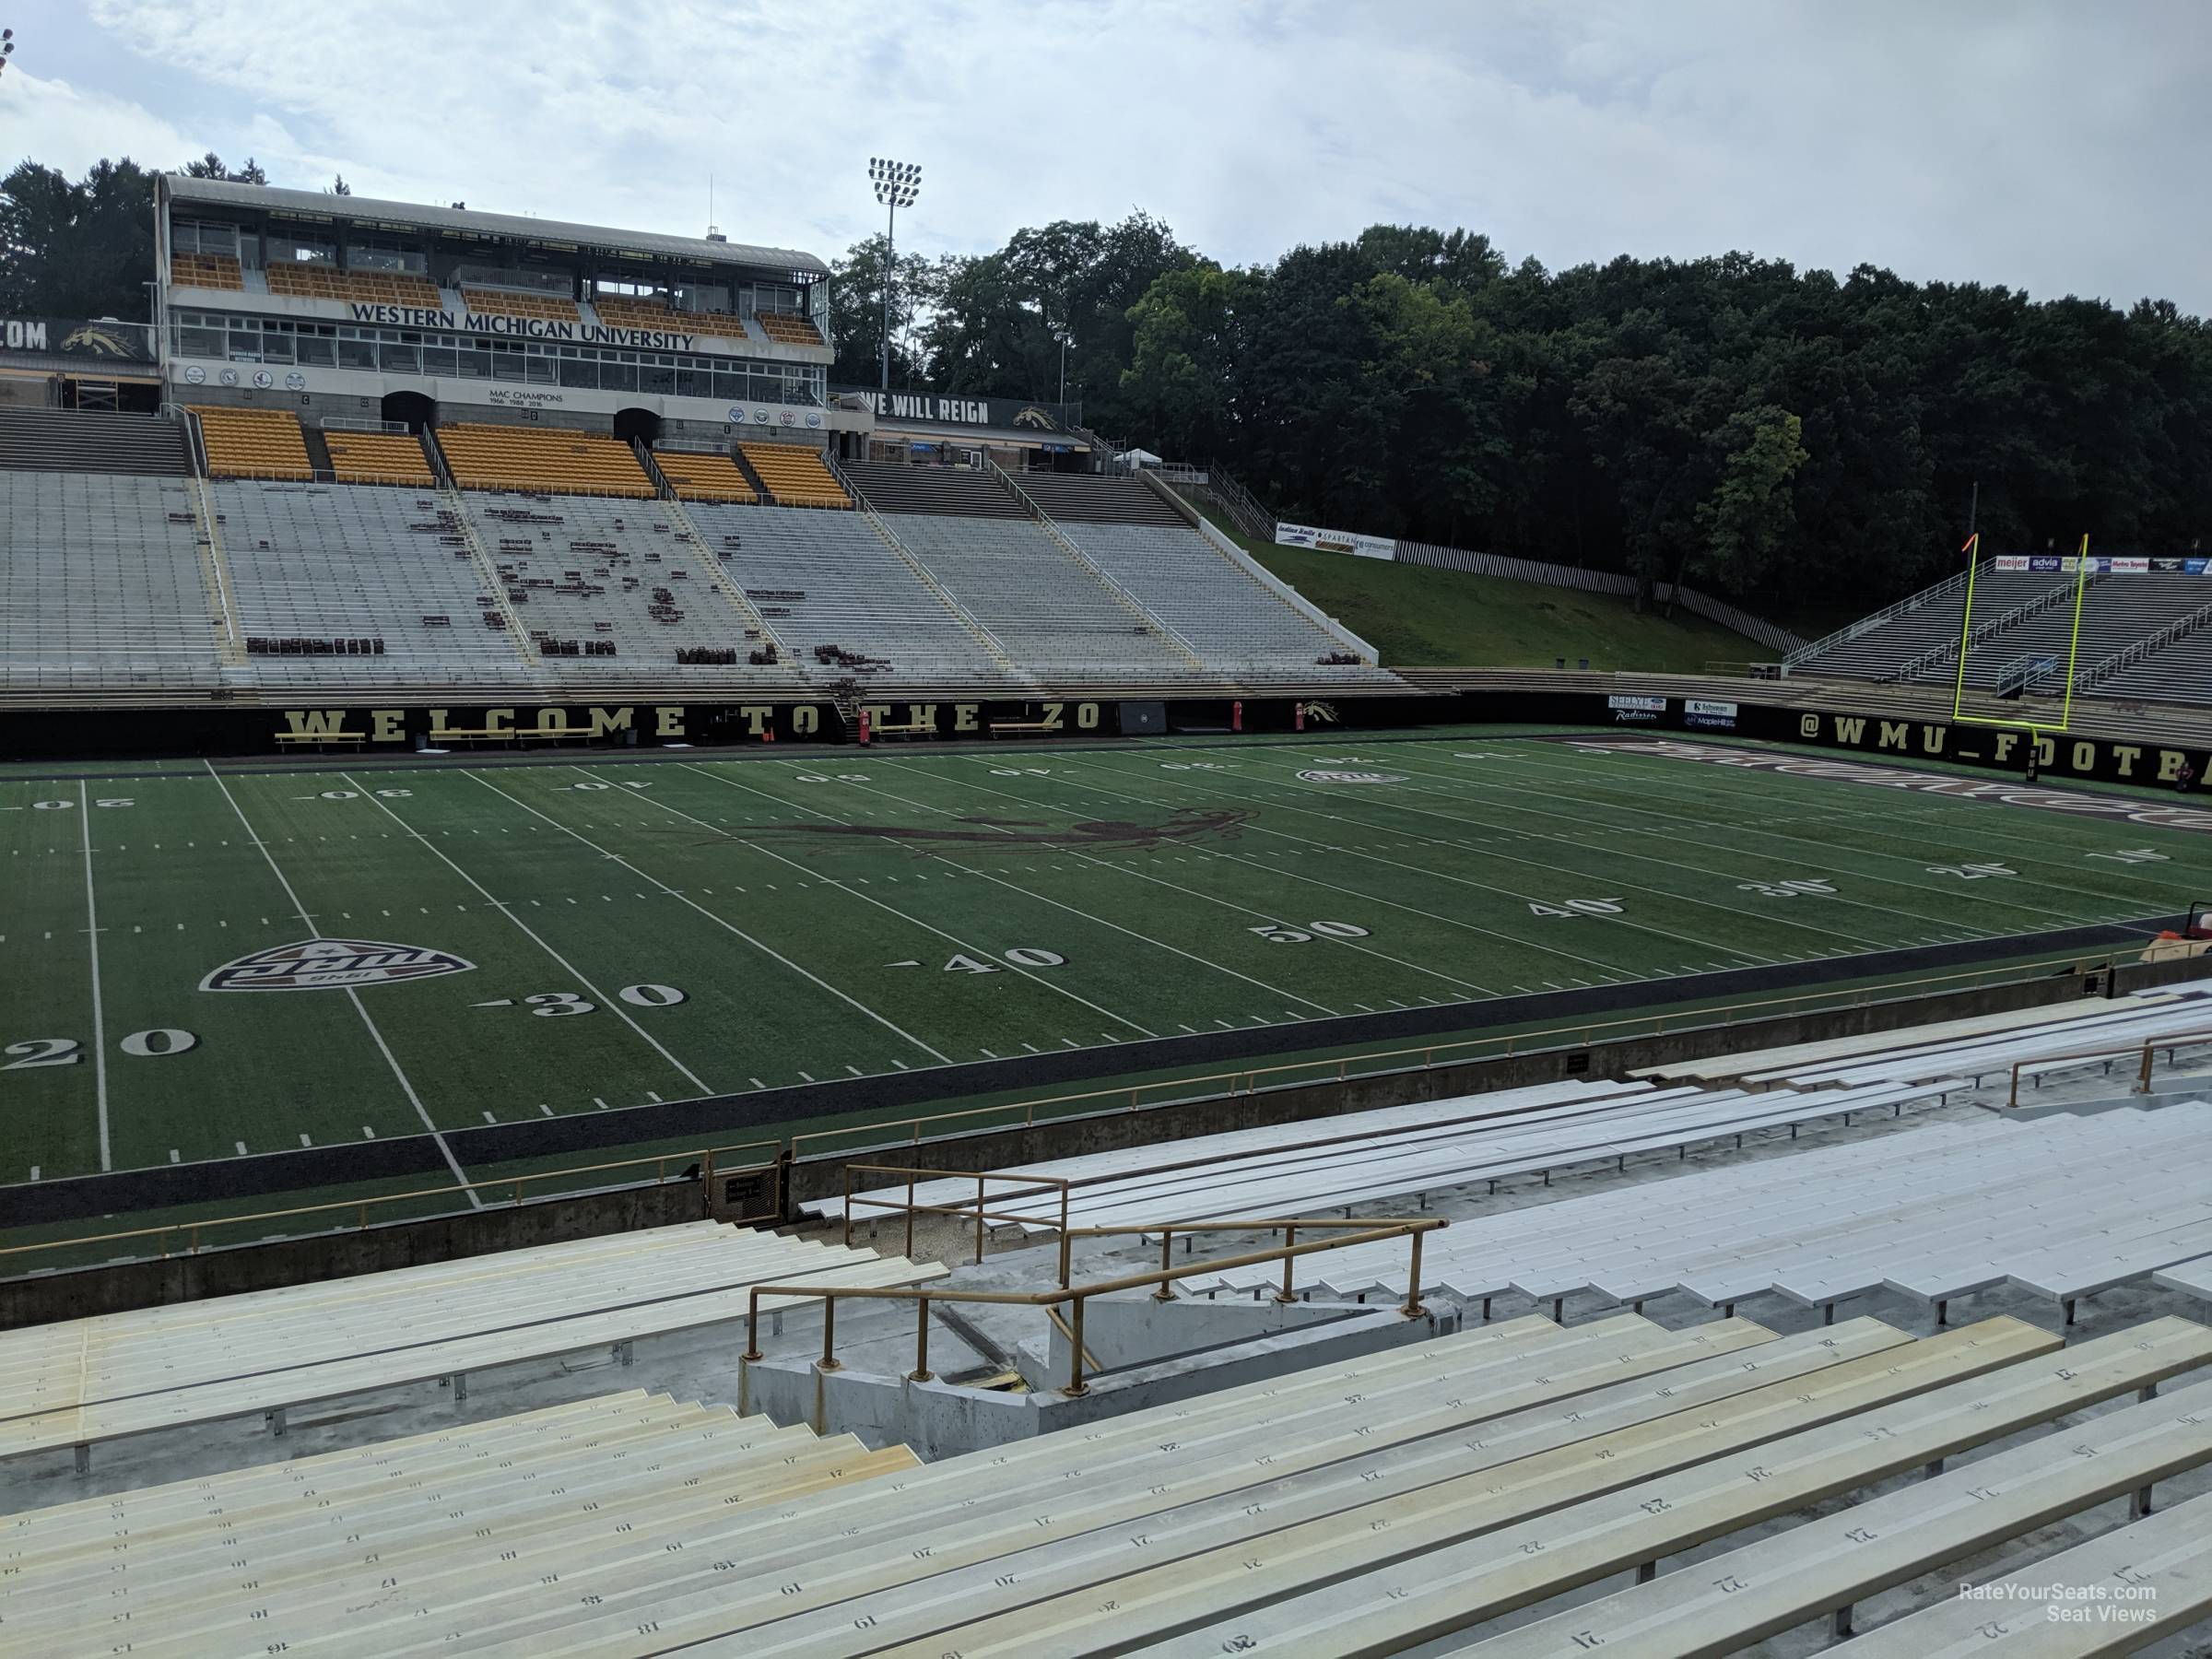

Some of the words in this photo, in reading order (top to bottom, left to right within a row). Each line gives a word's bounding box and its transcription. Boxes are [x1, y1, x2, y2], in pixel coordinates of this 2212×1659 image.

[351, 303, 454, 328] WESTERN
[465, 312, 573, 339] MICHIGAN
[581, 324, 693, 350] UNIVERSITY
[0, 321, 46, 349] OM
[489, 390, 510, 398] MAC
[512, 392, 563, 402] CHAMPIONS
[892, 394, 934, 419] WILL
[938, 398, 989, 424] REIGN
[1997, 557, 2028, 570] meijer
[2032, 558, 2058, 567] advia
[285, 707, 685, 742] WELCOME
[740, 705, 818, 735] TO
[862, 704, 979, 732] THE
[1247, 922, 1371, 944] 50
[912, 1547, 935, 1559] 20
[1519, 1540, 1545, 1554] 22
[994, 1573, 1021, 1587] 20
[1386, 1587, 1408, 1600] 21
[853, 1615, 877, 1630] 19
